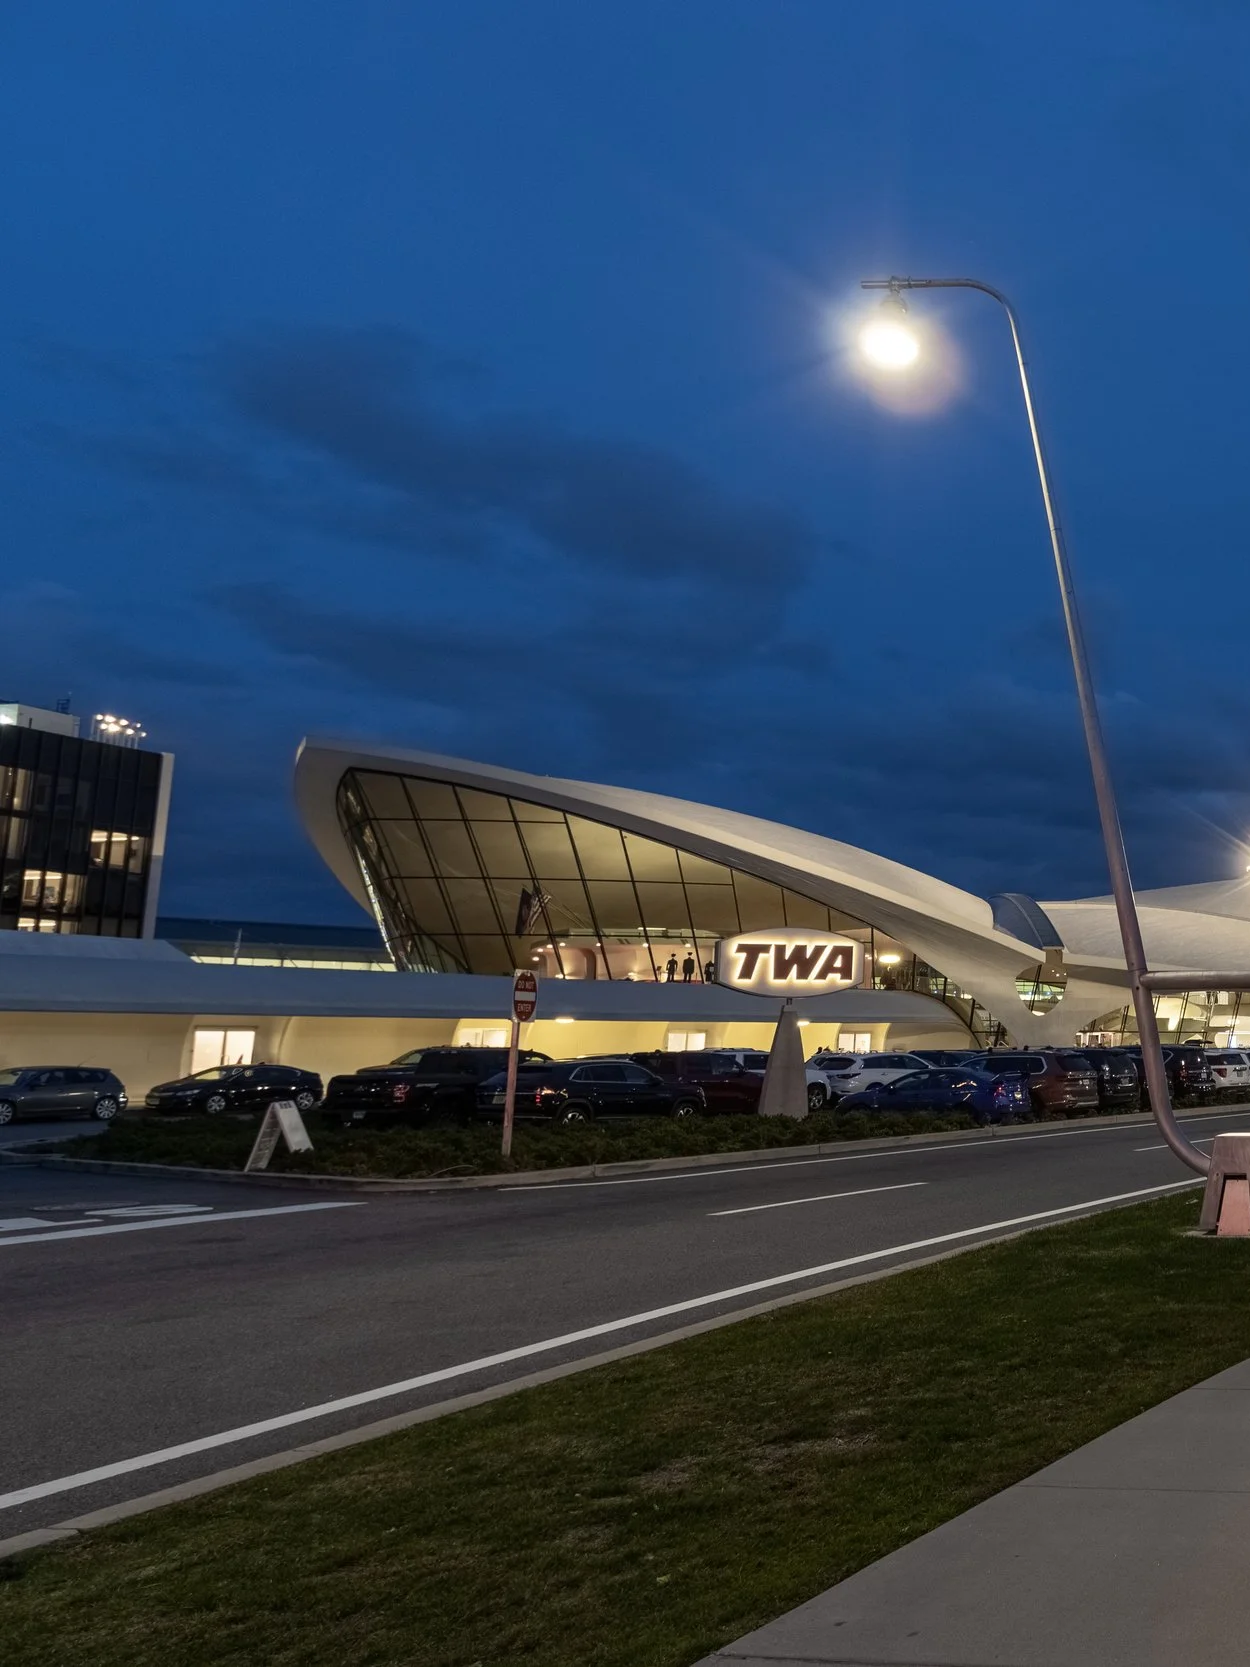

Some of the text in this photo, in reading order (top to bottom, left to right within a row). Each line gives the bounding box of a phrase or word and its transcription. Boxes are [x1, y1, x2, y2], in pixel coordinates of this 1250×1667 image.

[734, 943, 854, 981] TWA
[517, 980, 535, 990] DO NOT
[517, 1003, 532, 1012] ENTER
